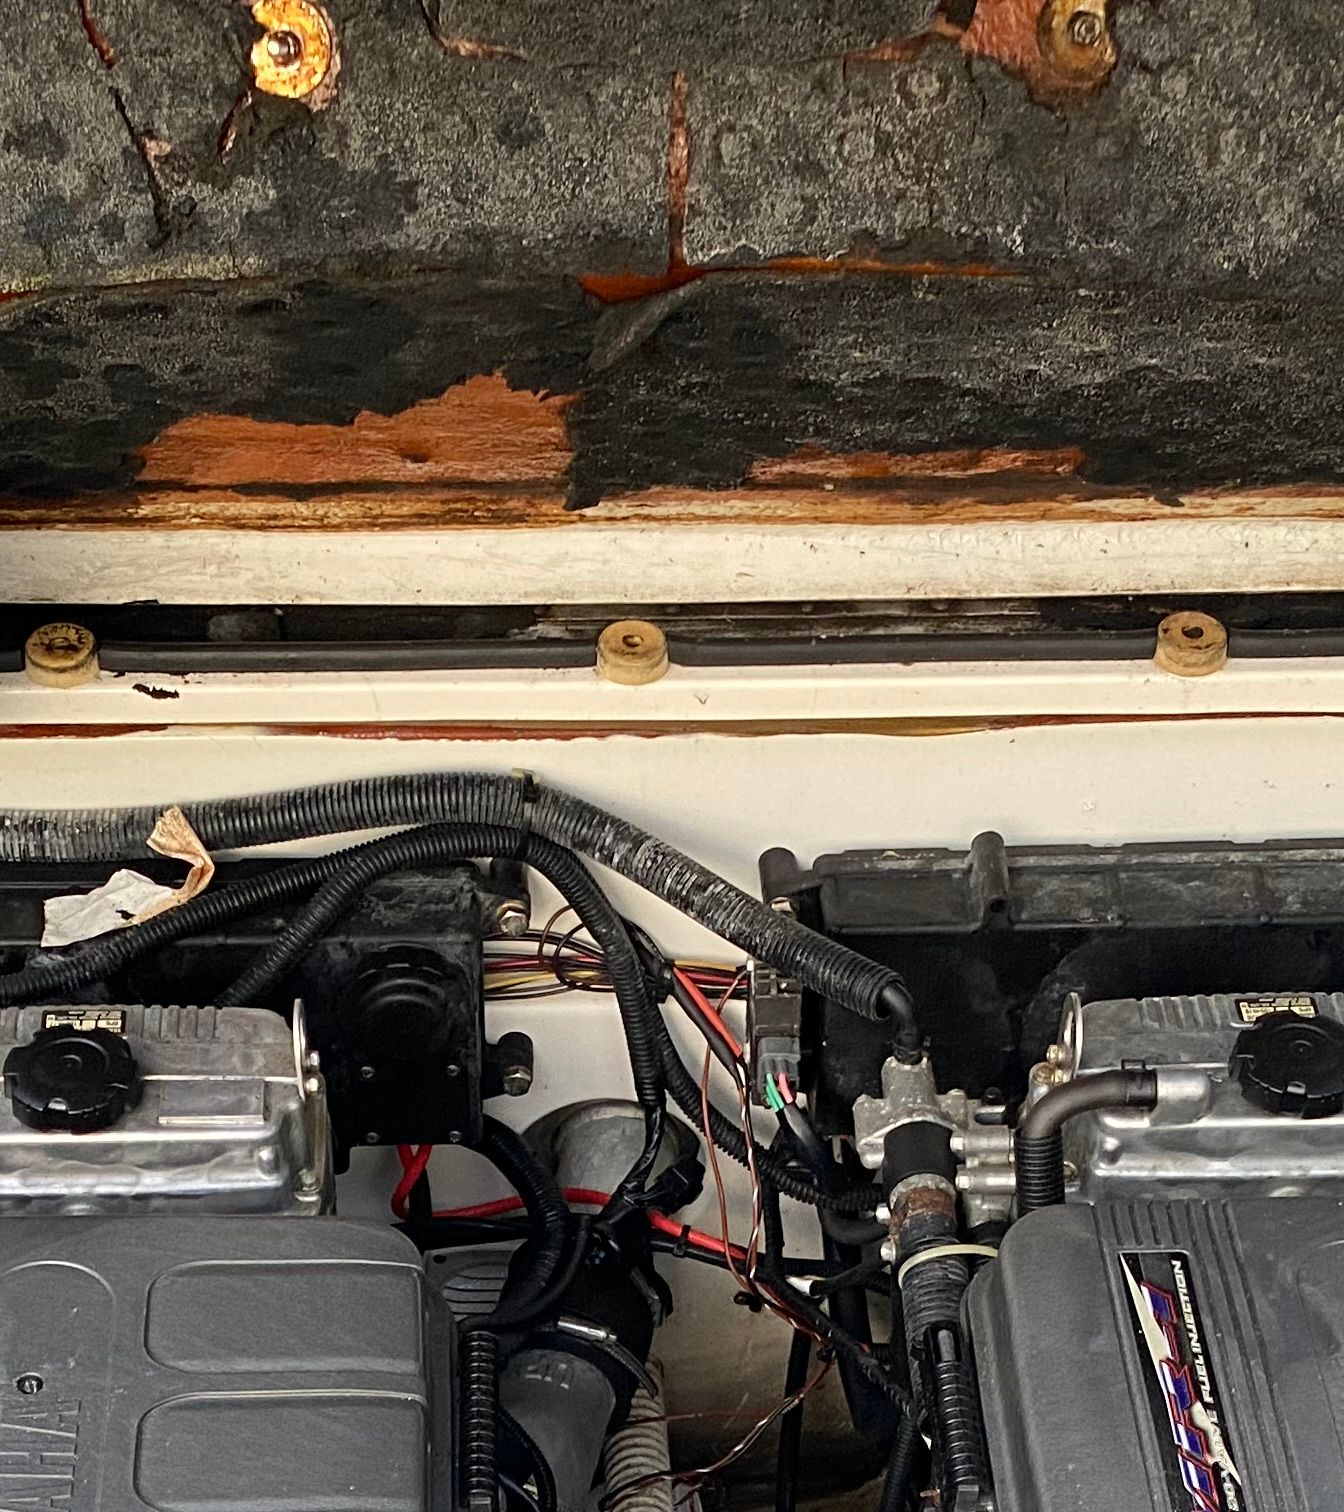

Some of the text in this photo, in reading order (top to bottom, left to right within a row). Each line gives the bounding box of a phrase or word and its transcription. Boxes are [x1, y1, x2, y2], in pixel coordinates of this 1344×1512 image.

[1170, 1260, 1239, 1512] 20-VALVE FUEL INJECTION
